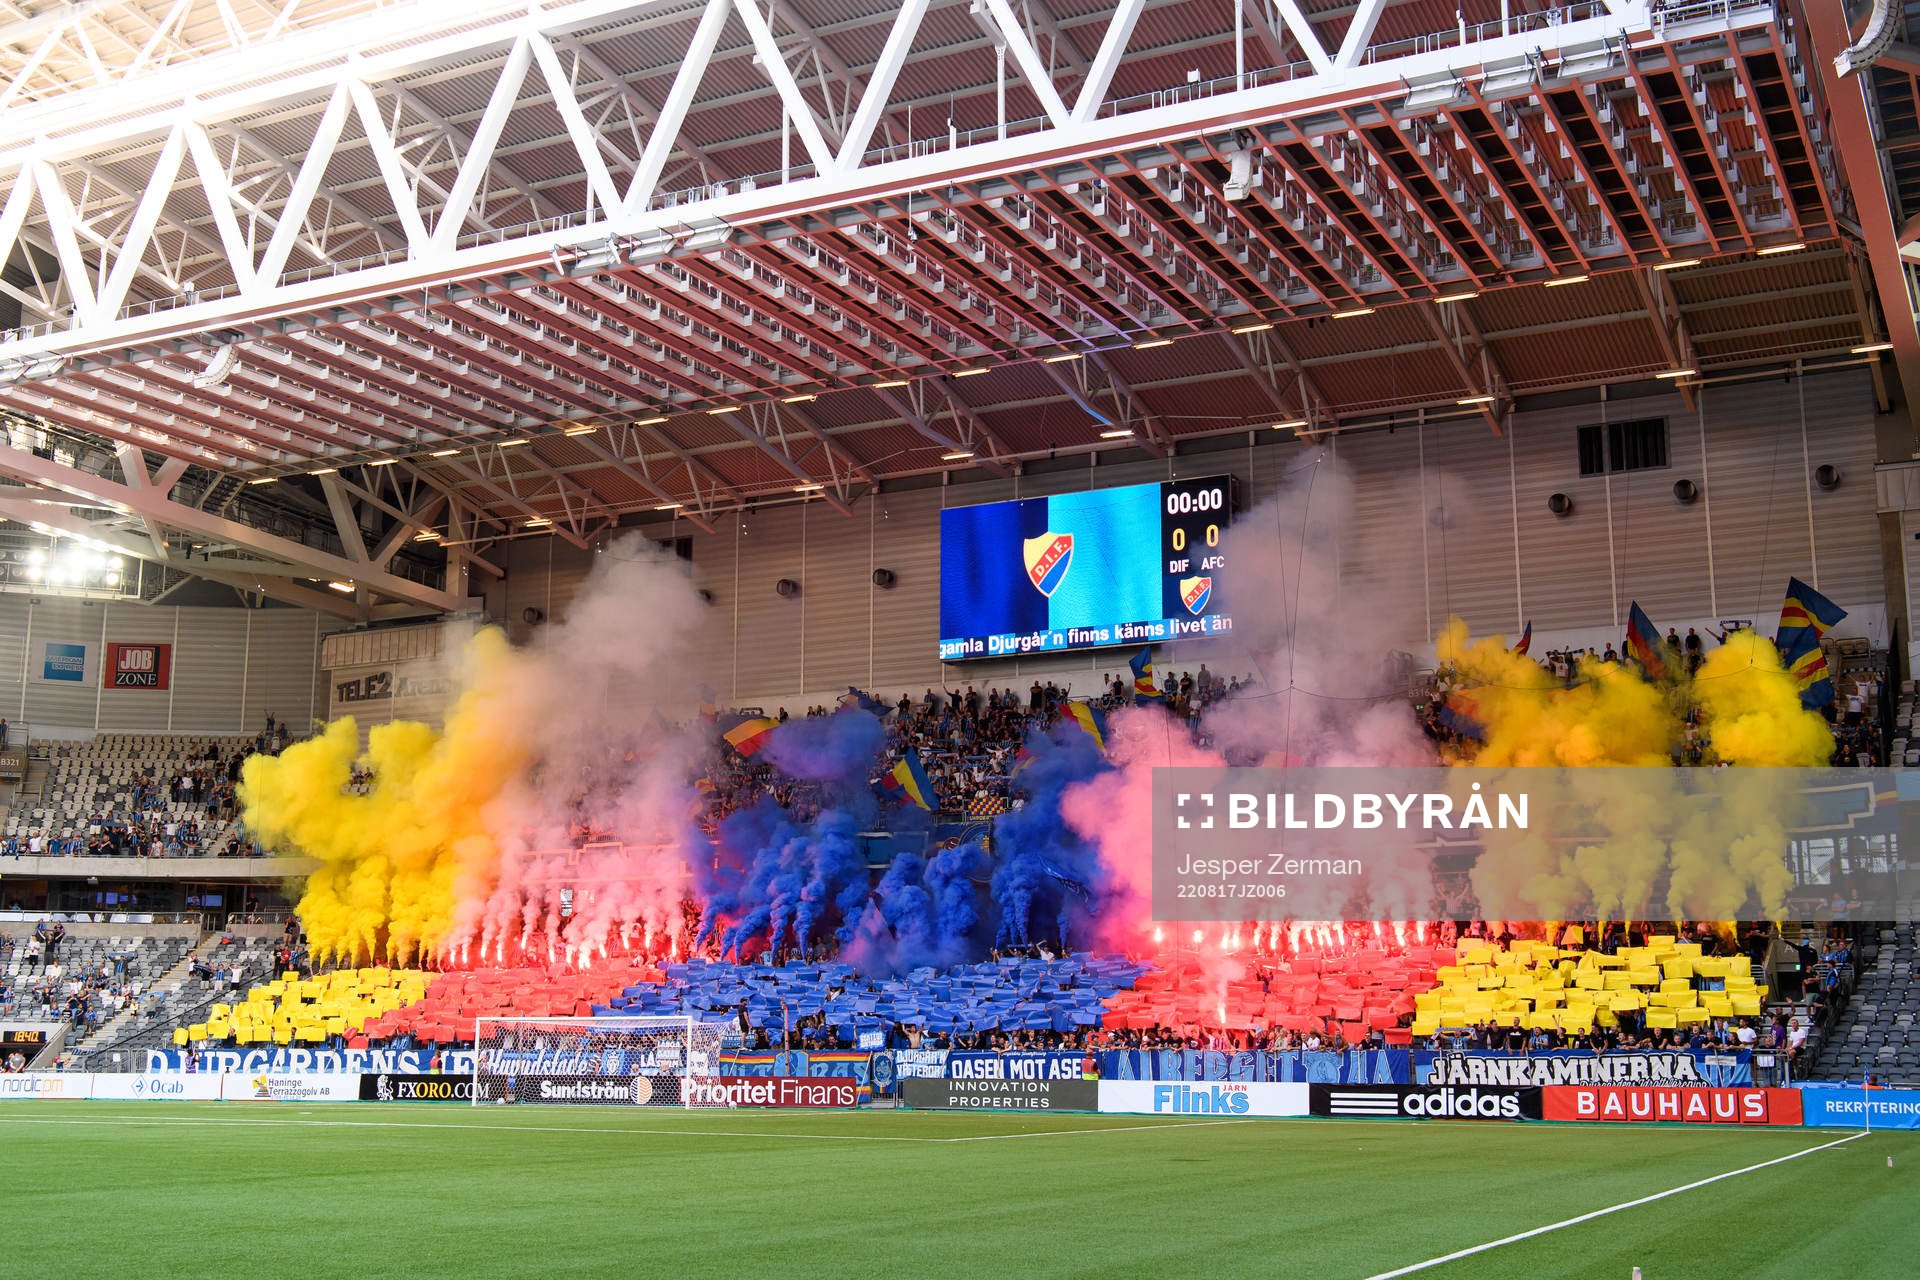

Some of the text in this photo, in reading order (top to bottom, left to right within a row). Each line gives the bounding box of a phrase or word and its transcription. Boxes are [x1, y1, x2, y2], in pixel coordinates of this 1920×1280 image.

[1167, 488, 1222, 514] 00:00
[1172, 524, 1219, 551] 0 0
[1034, 541, 1068, 577] D.I.F.
[1169, 555, 1225, 574] DIF AFC
[938, 637, 984, 658] gamla
[1067, 626, 1109, 645] finns
[1114, 619, 1165, 640] känns
[1169, 617, 1207, 636] livet
[1212, 614, 1233, 631] än
[121, 649, 153, 670] JOB
[116, 673, 156, 686] ZONE
[337, 671, 393, 702] TELE2
[0, 758, 20, 767] B321
[1009, 1058, 1045, 1079] MOT
[1050, 1058, 1085, 1080] ASE
[1427, 1053, 1697, 1086] JÄRNKAMINERNA
[151, 1079, 184, 1094] Ocab
[268, 1078, 302, 1088] Haninge
[269, 1087, 330, 1097] Terrazzogolv AB
[397, 1081, 490, 1099] FXORO.COM
[540, 1080, 628, 1099] Sundström
[680, 1078, 855, 1106] Prioritet Finans
[950, 1082, 1050, 1092] INNOVATION
[950, 1096, 1050, 1107] PROPERTIES
[1154, 1085, 1249, 1114] Flinks
[1403, 1087, 1520, 1117] adidas
[1577, 1090, 1763, 1117] BAUHAUS
